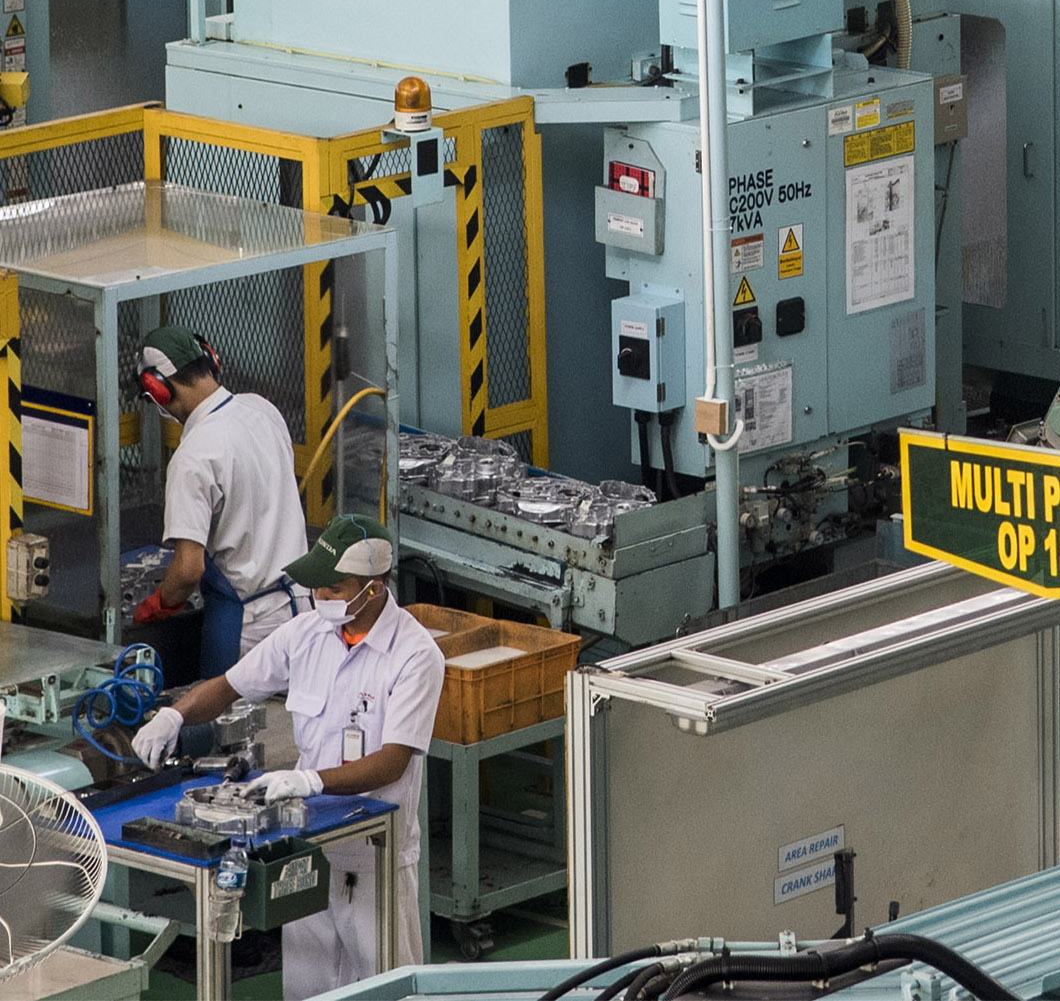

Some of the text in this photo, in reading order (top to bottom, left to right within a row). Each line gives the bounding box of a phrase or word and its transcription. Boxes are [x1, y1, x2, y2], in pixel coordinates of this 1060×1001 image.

[728, 168, 773, 196] PHASE
[729, 181, 812, 214] C200V 50Hz
[729, 210, 763, 234] 7kVA
[949, 459, 1036, 520] MULTI
[997, 521, 1036, 571] OP
[785, 834, 839, 863] AREA REPAIR
[781, 866, 835, 895] CRANK SHA
